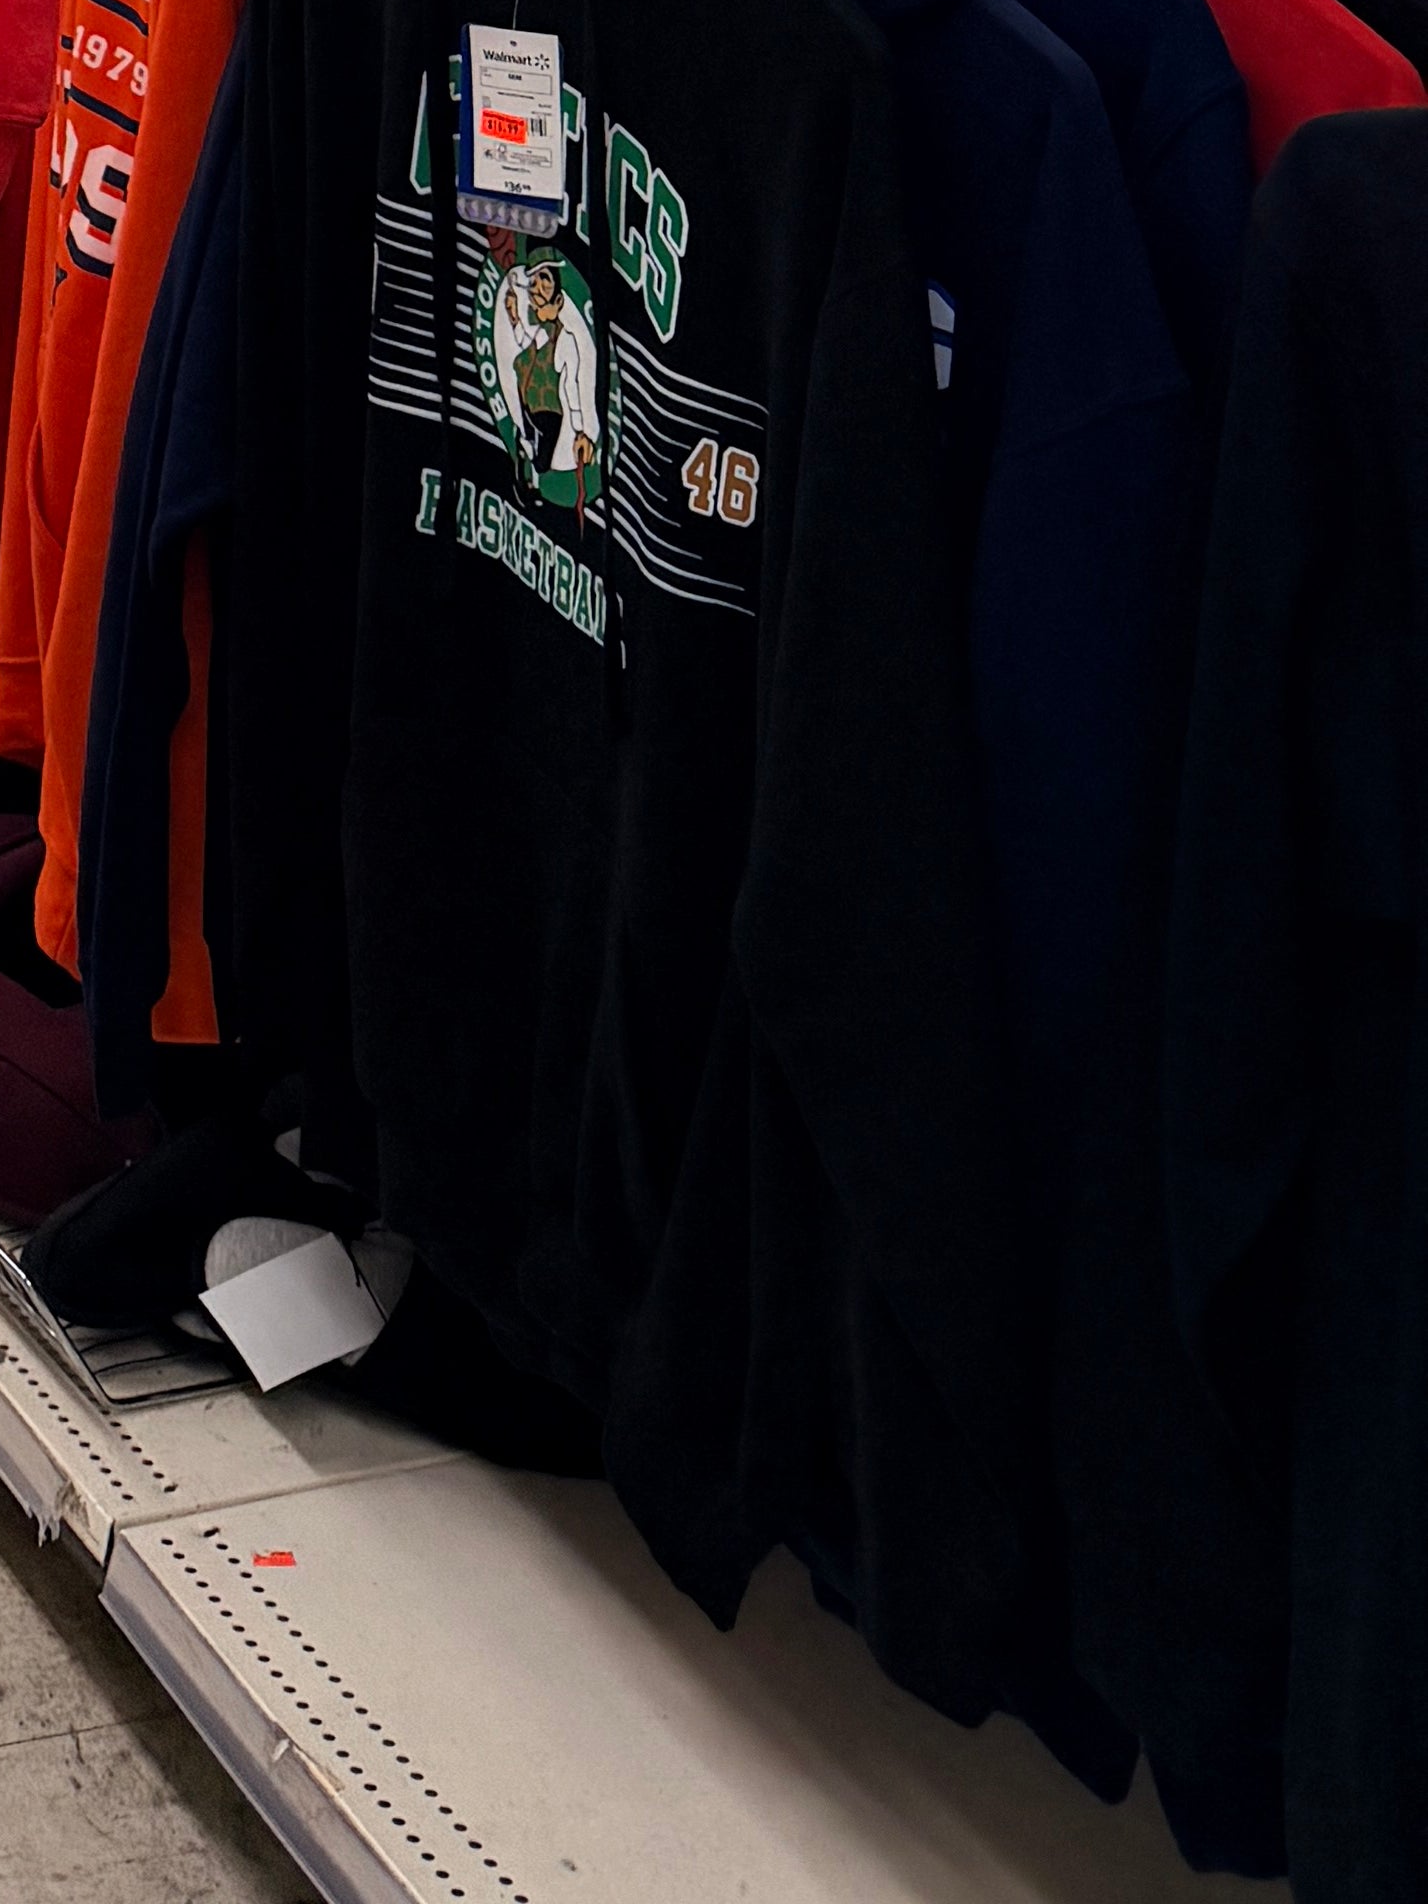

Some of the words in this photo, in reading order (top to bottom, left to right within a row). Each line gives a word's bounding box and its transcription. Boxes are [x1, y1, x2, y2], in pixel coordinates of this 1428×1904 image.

[72, 24, 150, 97] 1979
[482, 48, 533, 67] Walmart
[474, 258, 510, 422] BOSTON
[681, 437, 761, 528] 46
